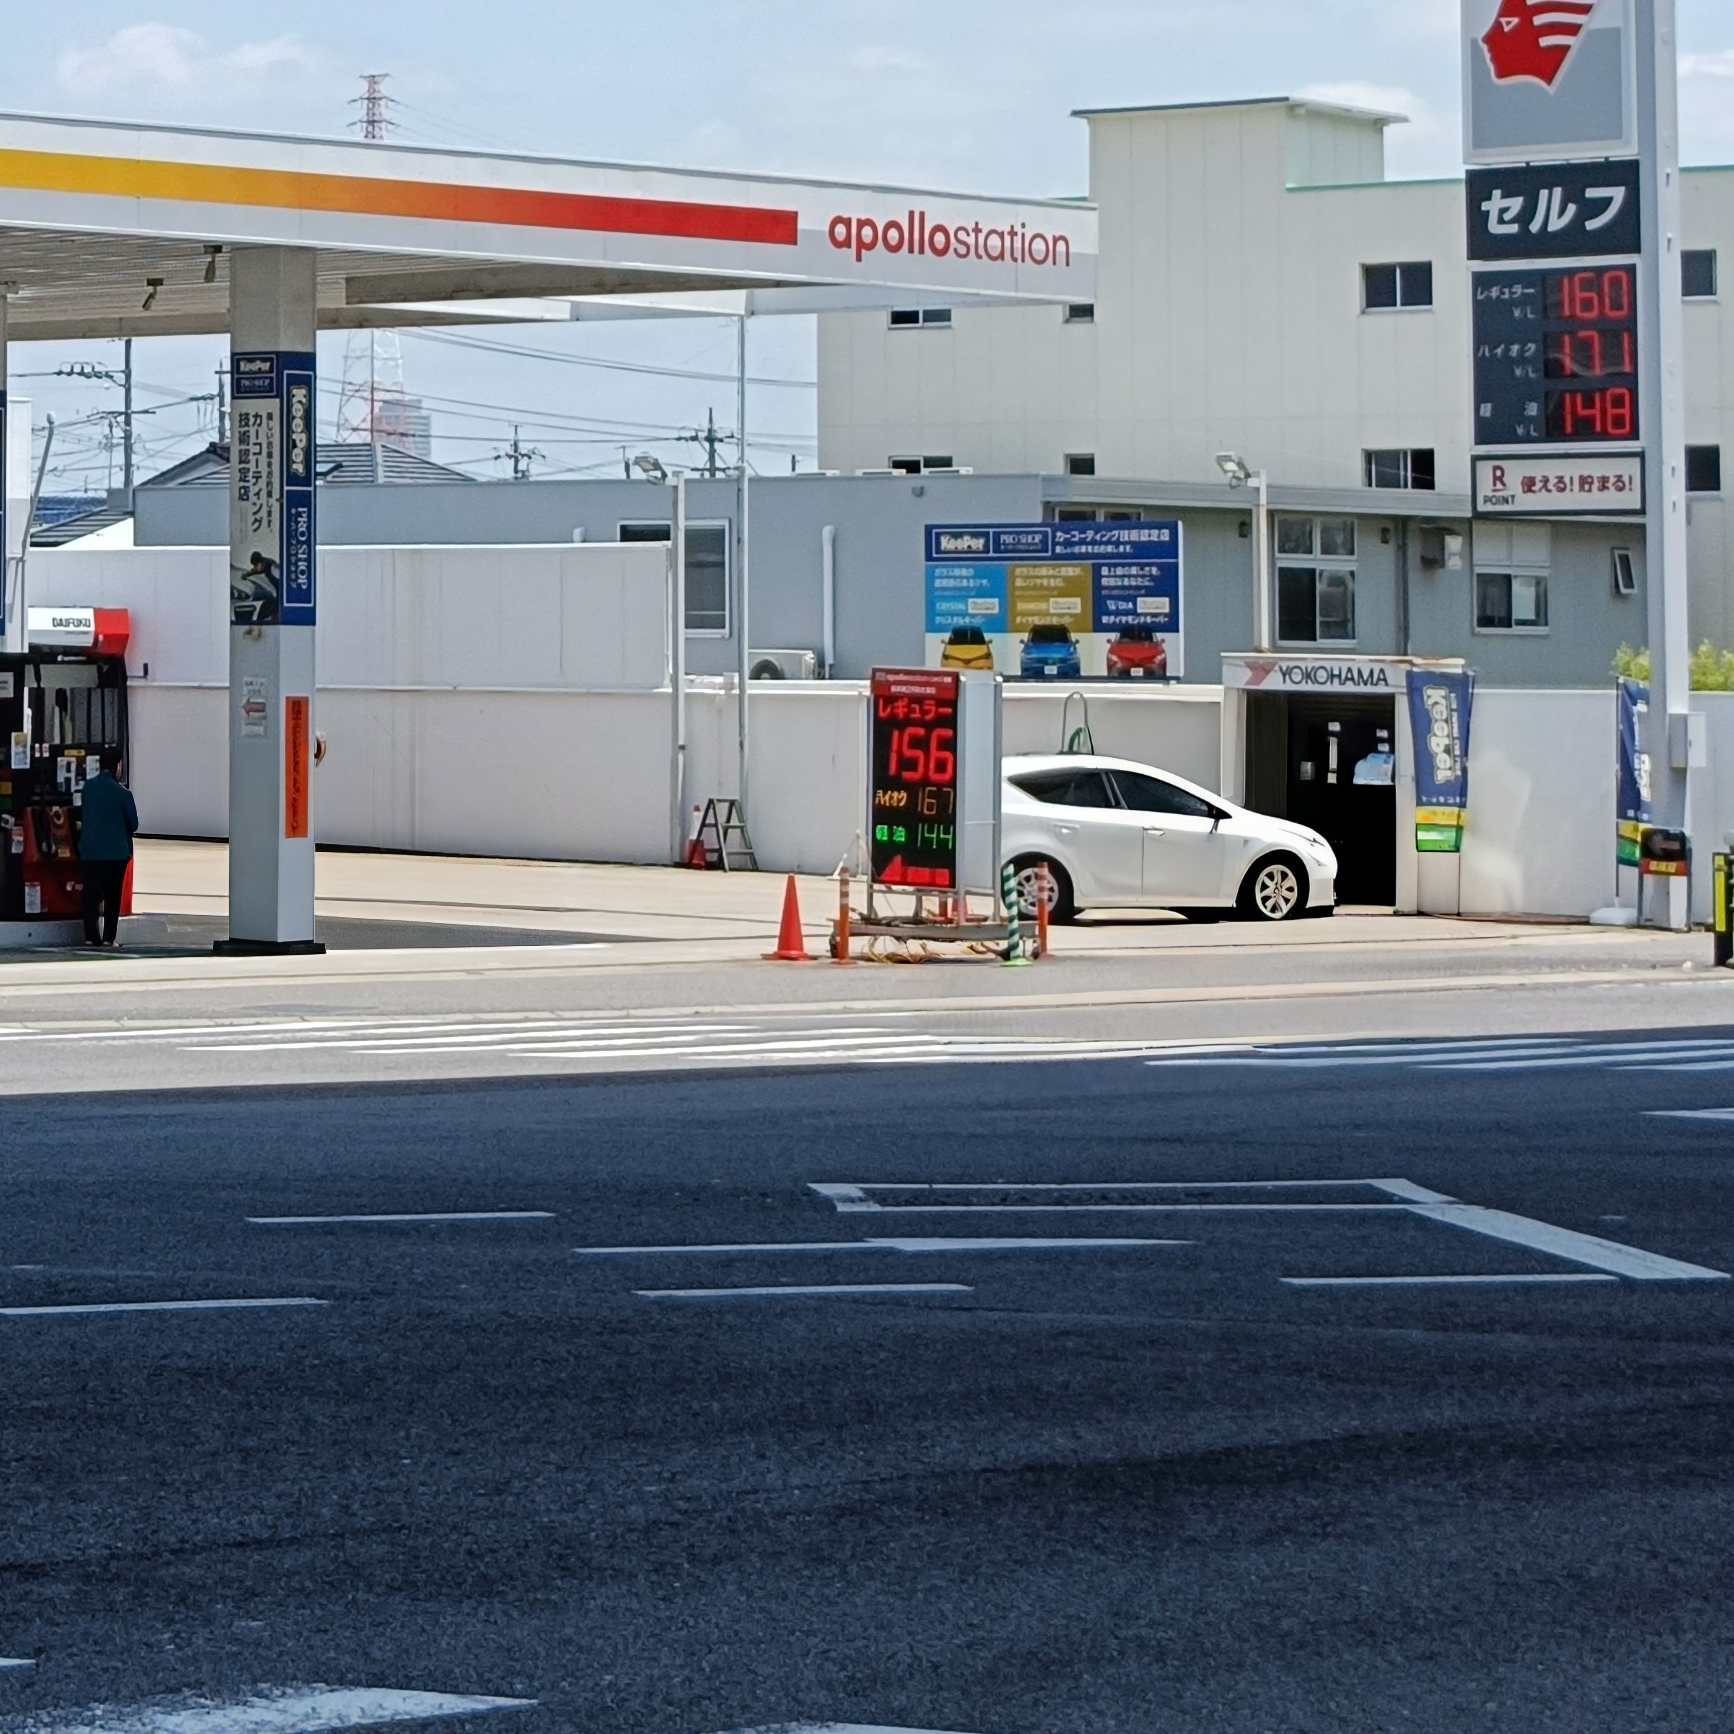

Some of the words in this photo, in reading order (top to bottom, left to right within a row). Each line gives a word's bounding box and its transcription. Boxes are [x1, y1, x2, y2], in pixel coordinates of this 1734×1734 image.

[1481, 185, 1627, 236] セルフ
[828, 209, 1071, 268] apollostation
[1476, 283, 1536, 301] レギュラー
[1563, 270, 1630, 320] 160
[1477, 342, 1537, 359] ハイオク
[1563, 329, 1633, 377] 171
[291, 387, 307, 474] KeePer
[1564, 387, 1633, 436] 148
[237, 412, 251, 501] 技術認定店
[251, 411, 263, 533] カーコーティング
[297, 507, 308, 541] PRO
[1482, 494, 1516, 506] POINT
[297, 543, 308, 590] SHOP
[940, 534, 986, 551] KeePer
[1279, 665, 1389, 687] YOKOHAMA
[878, 697, 953, 721] レギュラー
[889, 726, 955, 782] 156
[917, 786, 954, 815] 167
[917, 823, 954, 850] 144
